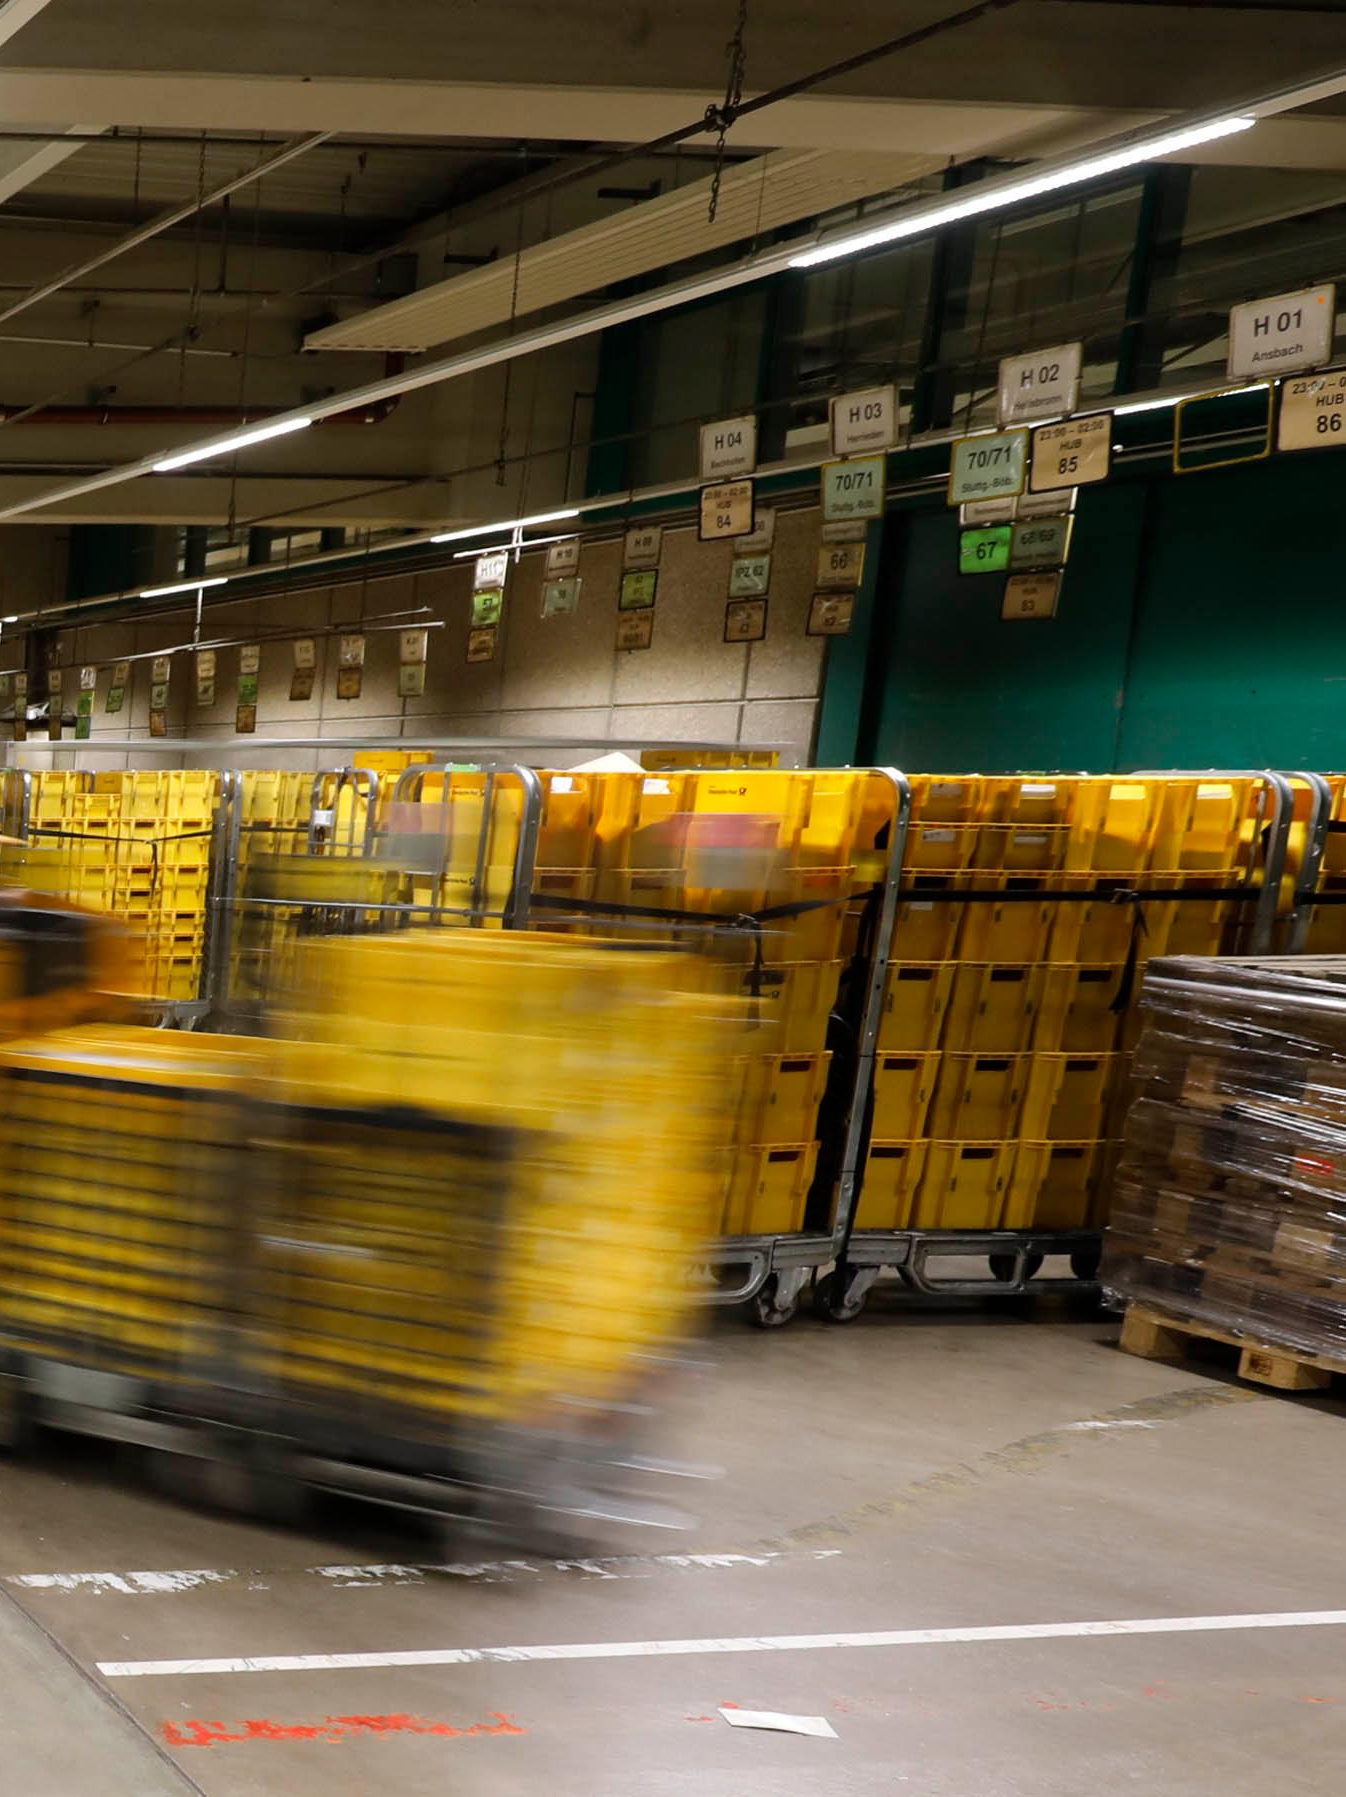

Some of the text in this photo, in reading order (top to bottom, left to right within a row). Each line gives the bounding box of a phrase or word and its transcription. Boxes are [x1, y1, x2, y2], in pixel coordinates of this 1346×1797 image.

[1253, 309, 1303, 337] H 01
[1251, 343, 1304, 363] Ansbach
[1020, 363, 1060, 387] H 02
[1316, 393, 1344, 407] HUB
[849, 402, 882, 424] H 03
[1316, 412, 1342, 433] 86
[714, 431, 742, 450] H 04
[967, 445, 1012, 471] 70/71
[1058, 455, 1078, 475] 85
[835, 471, 873, 491] 70/71
[716, 515, 732, 529] 84
[976, 541, 997, 560] 67
[829, 552, 849, 571] 66
